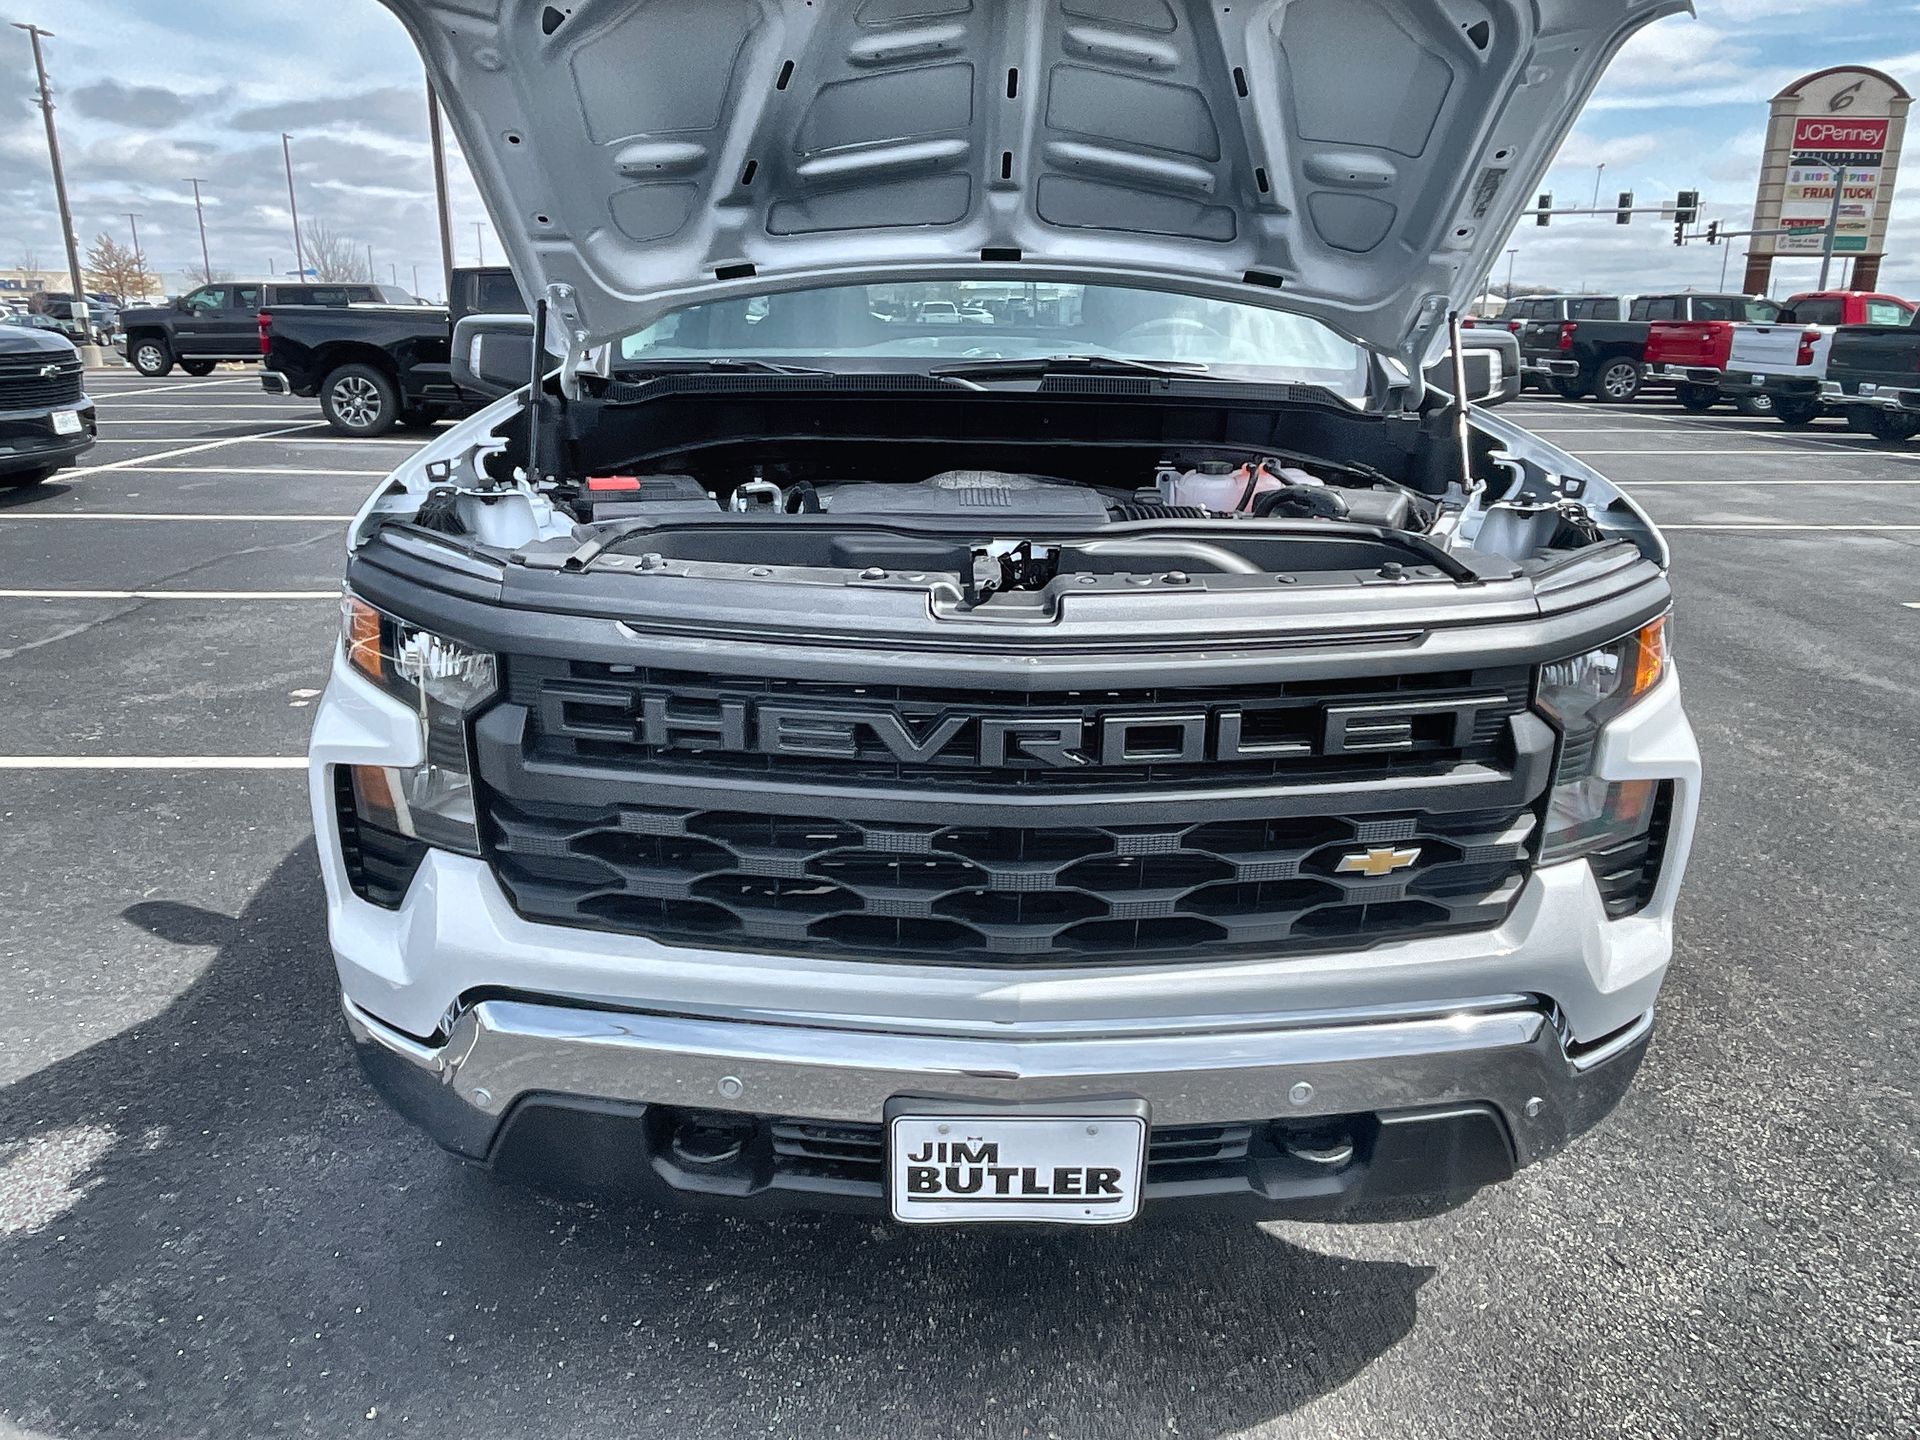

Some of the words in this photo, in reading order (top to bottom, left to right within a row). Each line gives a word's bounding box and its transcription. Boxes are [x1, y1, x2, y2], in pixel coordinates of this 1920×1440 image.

[1798, 123, 1884, 145] JCPenney
[1804, 172, 1829, 181] KIDS
[1833, 173, 1876, 182] EPIRE
[1843, 187, 1874, 199] TUCK
[539, 688, 1509, 767] CHEVROLET
[907, 1142, 999, 1164] JIM
[907, 1166, 1124, 1195] BUTLER
